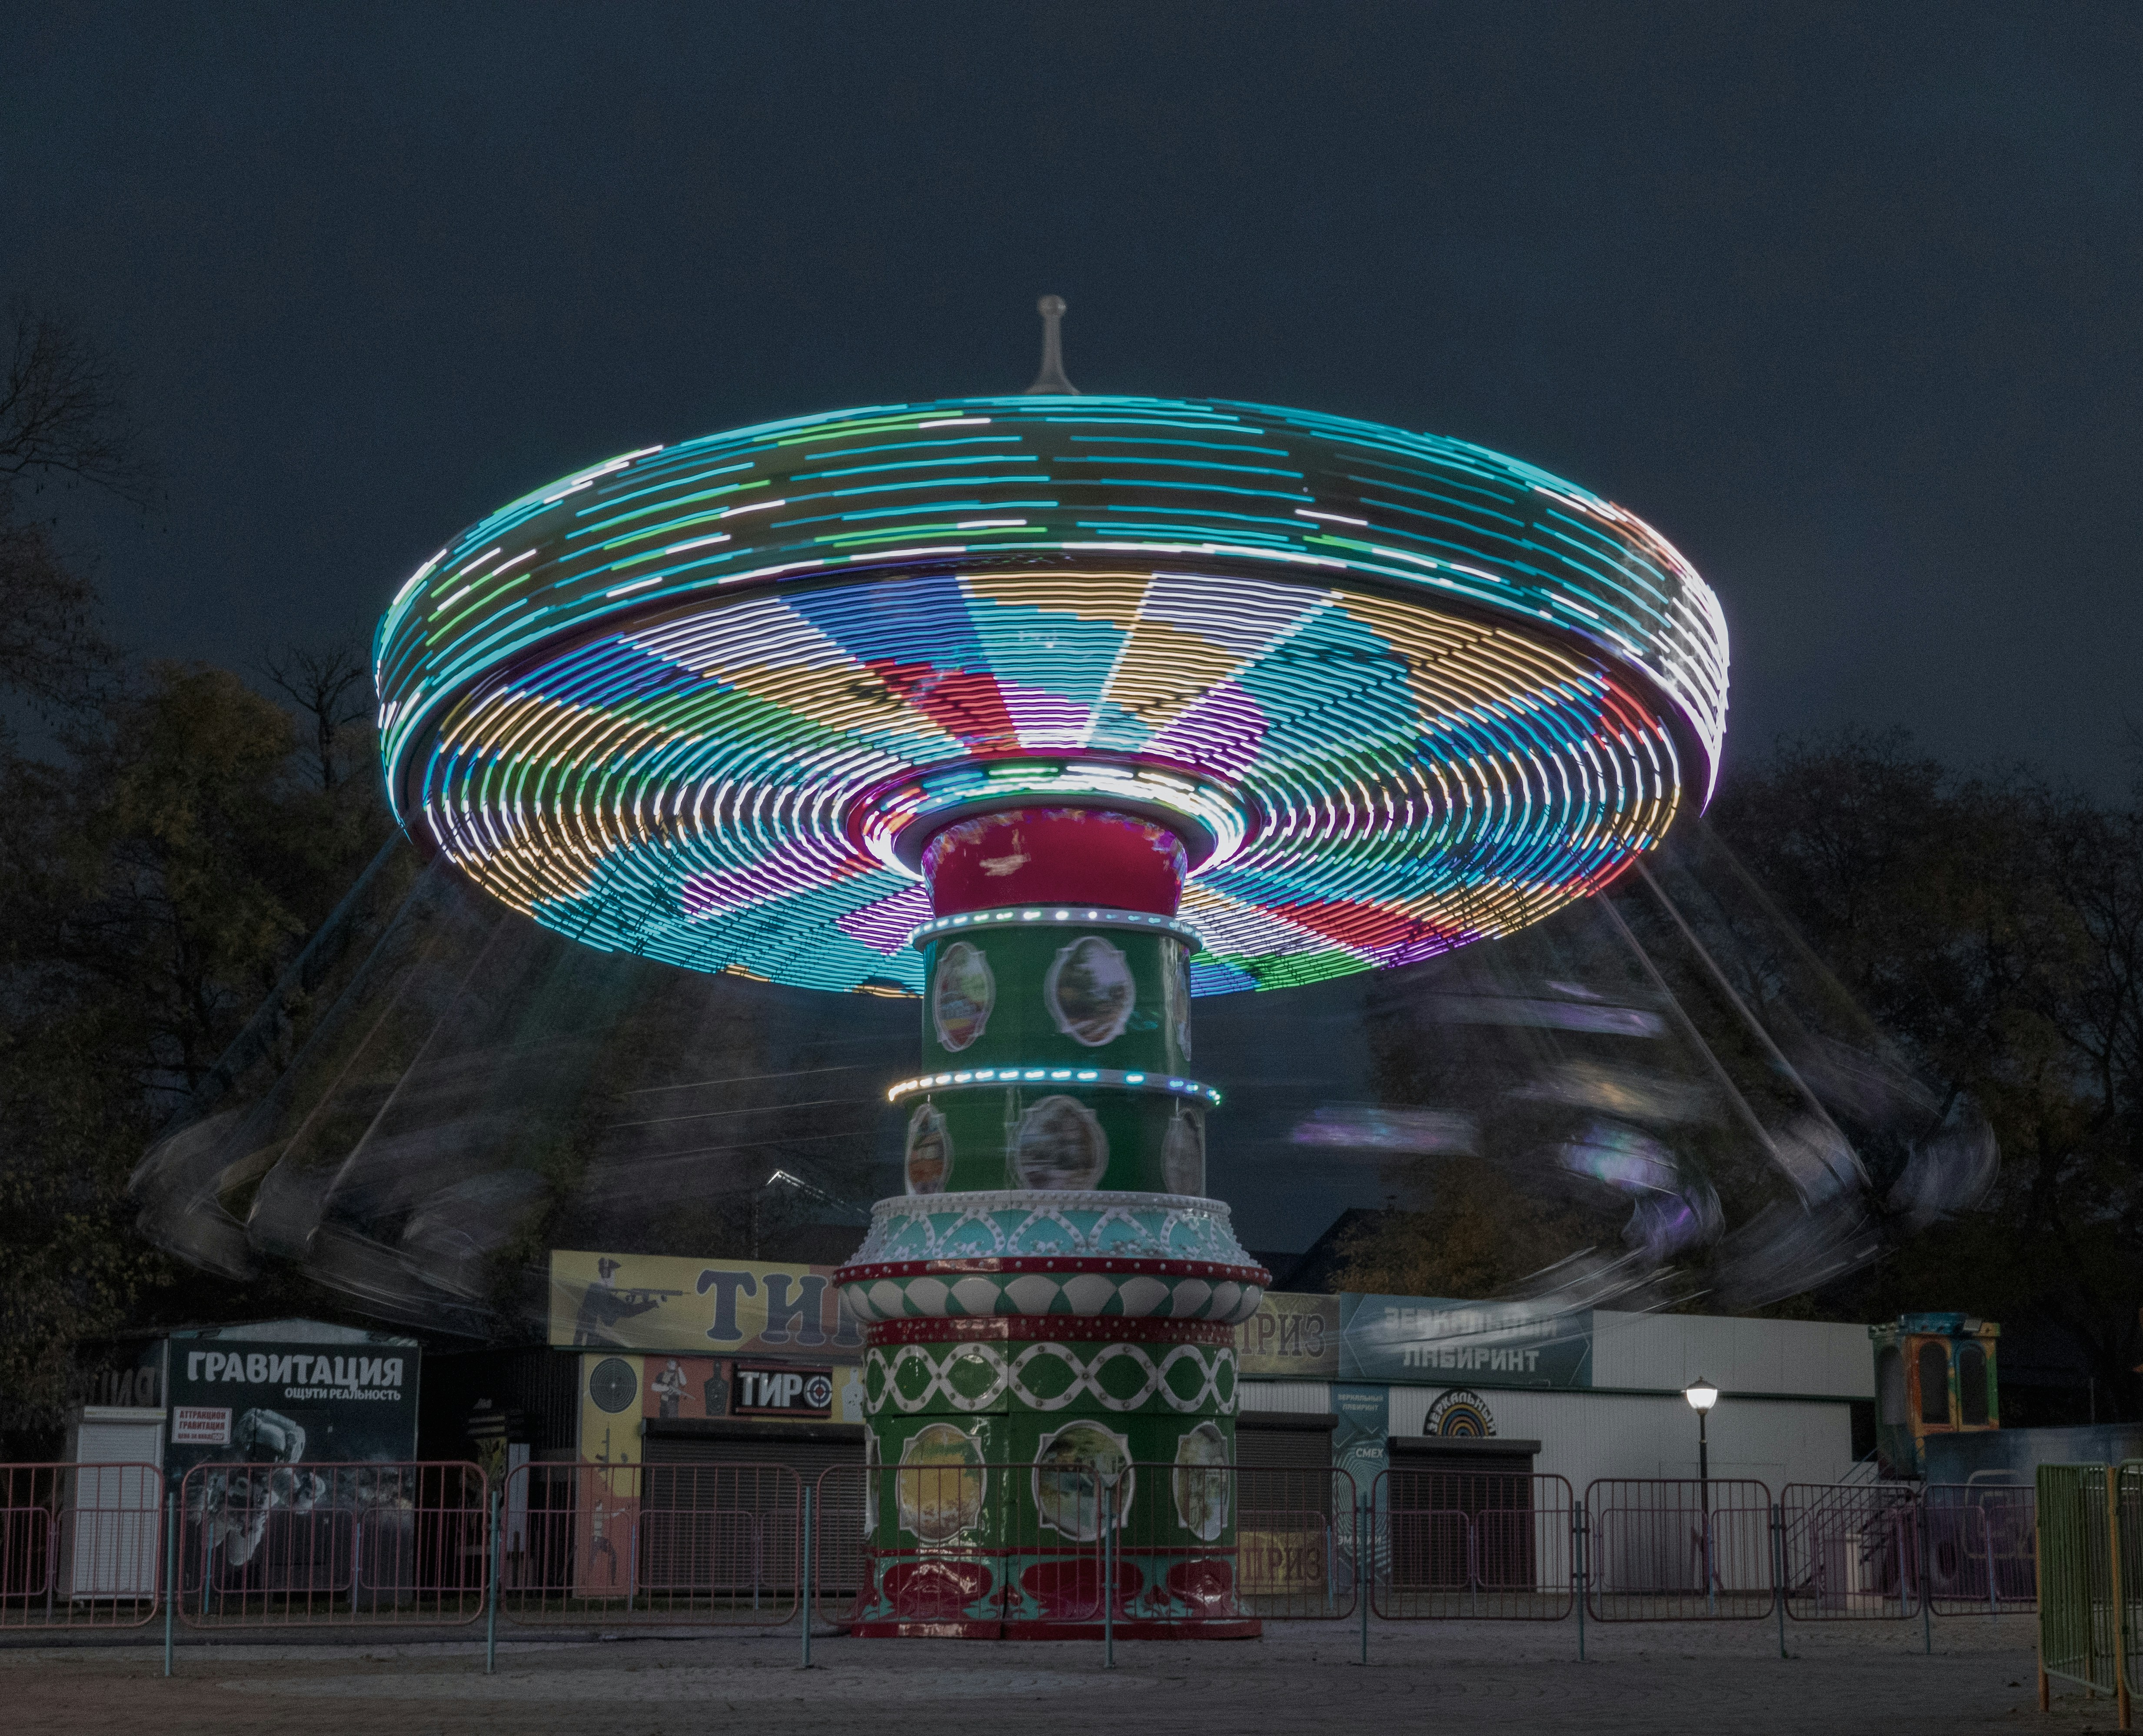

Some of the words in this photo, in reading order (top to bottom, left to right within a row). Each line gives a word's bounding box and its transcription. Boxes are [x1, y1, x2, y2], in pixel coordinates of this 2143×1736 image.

[1403, 1347, 1539, 1372] ЛАБИРИНТ
[187, 1351, 403, 1391] ГРАВИТАЦИЯ
[285, 1387, 327, 1400] ОЩУТИ
[329, 1389, 401, 1400] РЕАЛЬНОСТЬ
[738, 1371, 802, 1407] ТИР
[180, 1411, 226, 1419] АТТРАКЦИОН
[179, 1421, 225, 1430] ГРАВИТАЦИЯ
[1356, 1448, 1384, 1458] СМЕХ
[1244, 1547, 1321, 1580] ПРИЗ
